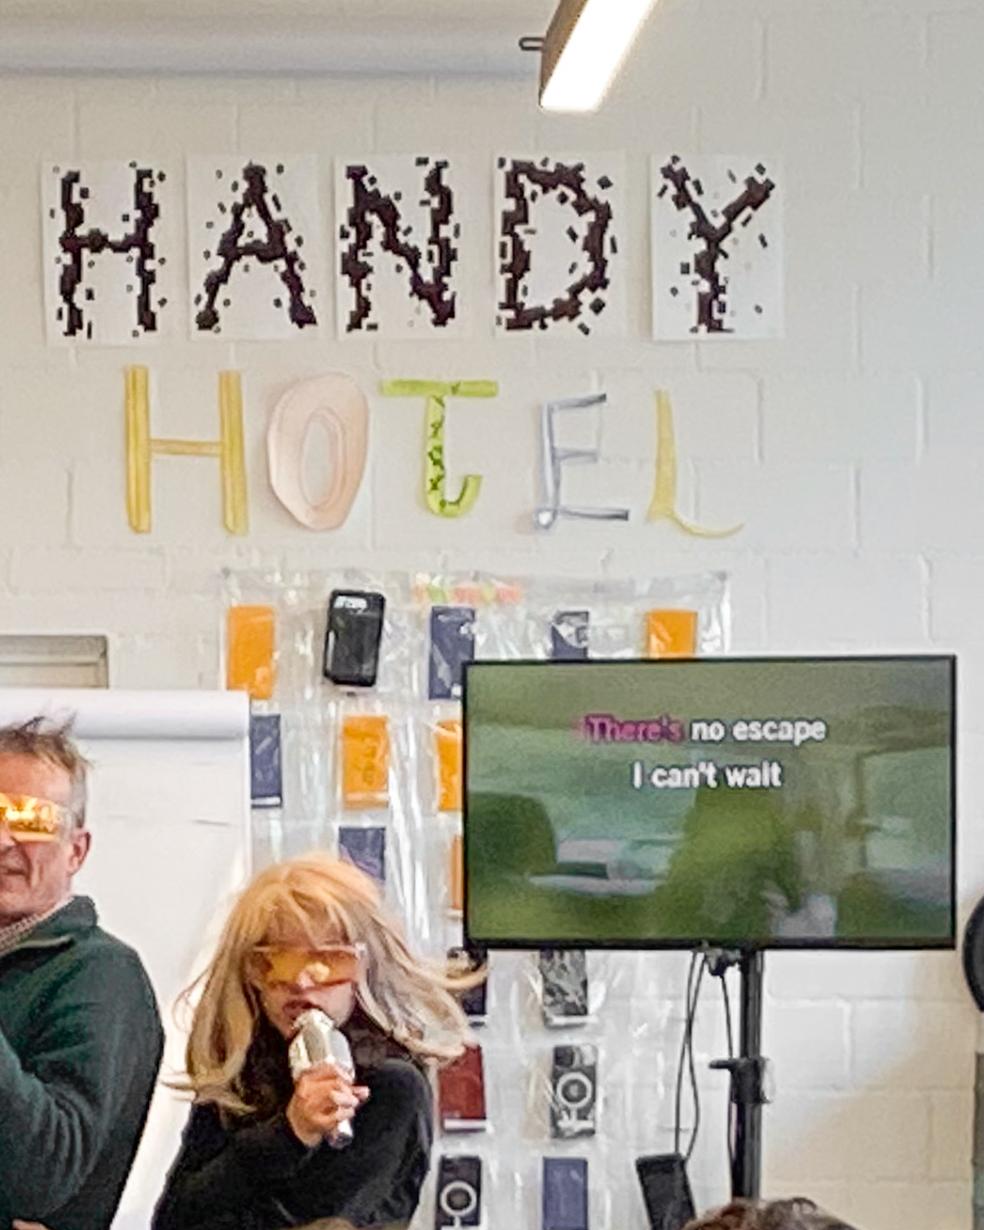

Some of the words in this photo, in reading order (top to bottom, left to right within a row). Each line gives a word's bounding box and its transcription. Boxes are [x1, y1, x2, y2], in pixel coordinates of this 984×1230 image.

[58, 155, 776, 336] HANDY
[124, 363, 746, 538] HOTEL
[586, 715, 683, 741] There's
[692, 720, 725, 740] no
[732, 719, 826, 745] escape
[633, 761, 642, 788] I
[651, 762, 717, 788] can't
[726, 761, 782, 788] wait
